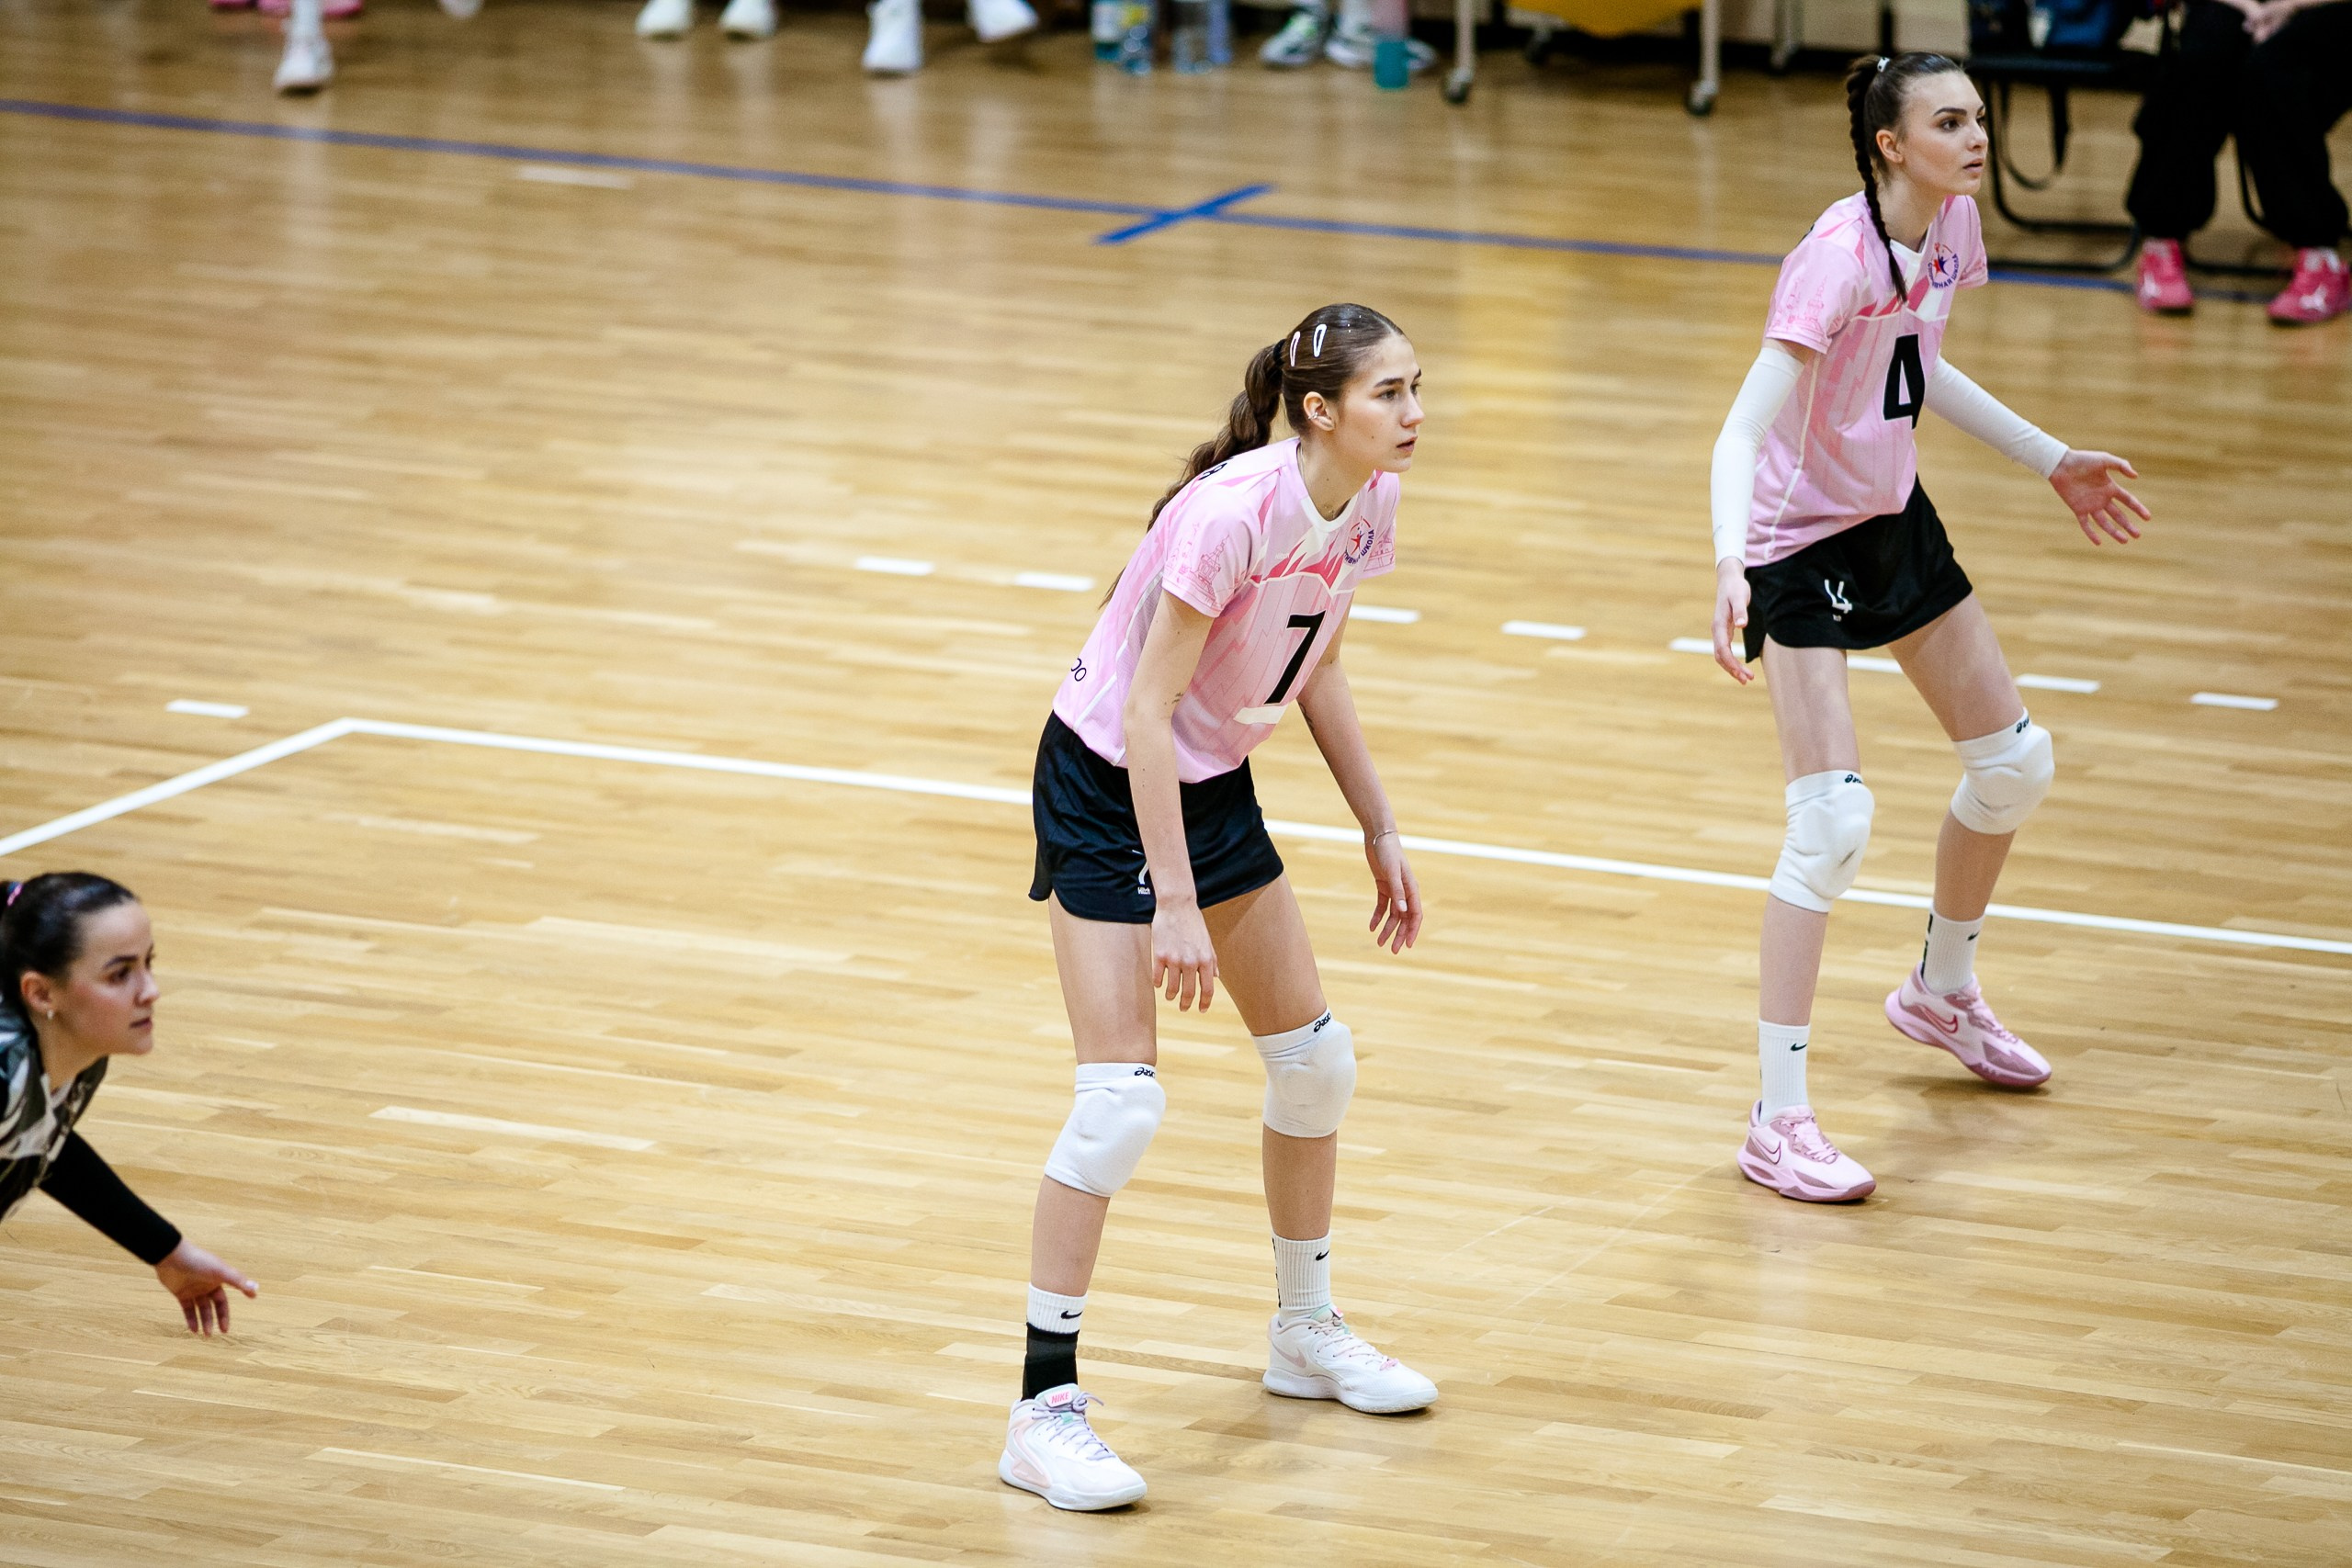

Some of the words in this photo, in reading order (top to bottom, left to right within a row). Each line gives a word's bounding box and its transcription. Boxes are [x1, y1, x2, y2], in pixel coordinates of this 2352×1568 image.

[1883, 333, 1926, 430] 4
[1361, 529, 1374, 557] ШКОЛА
[1824, 579, 1853, 615] 4
[1263, 610, 1326, 705] 7
[1051, 1392, 1069, 1404] NIKE
